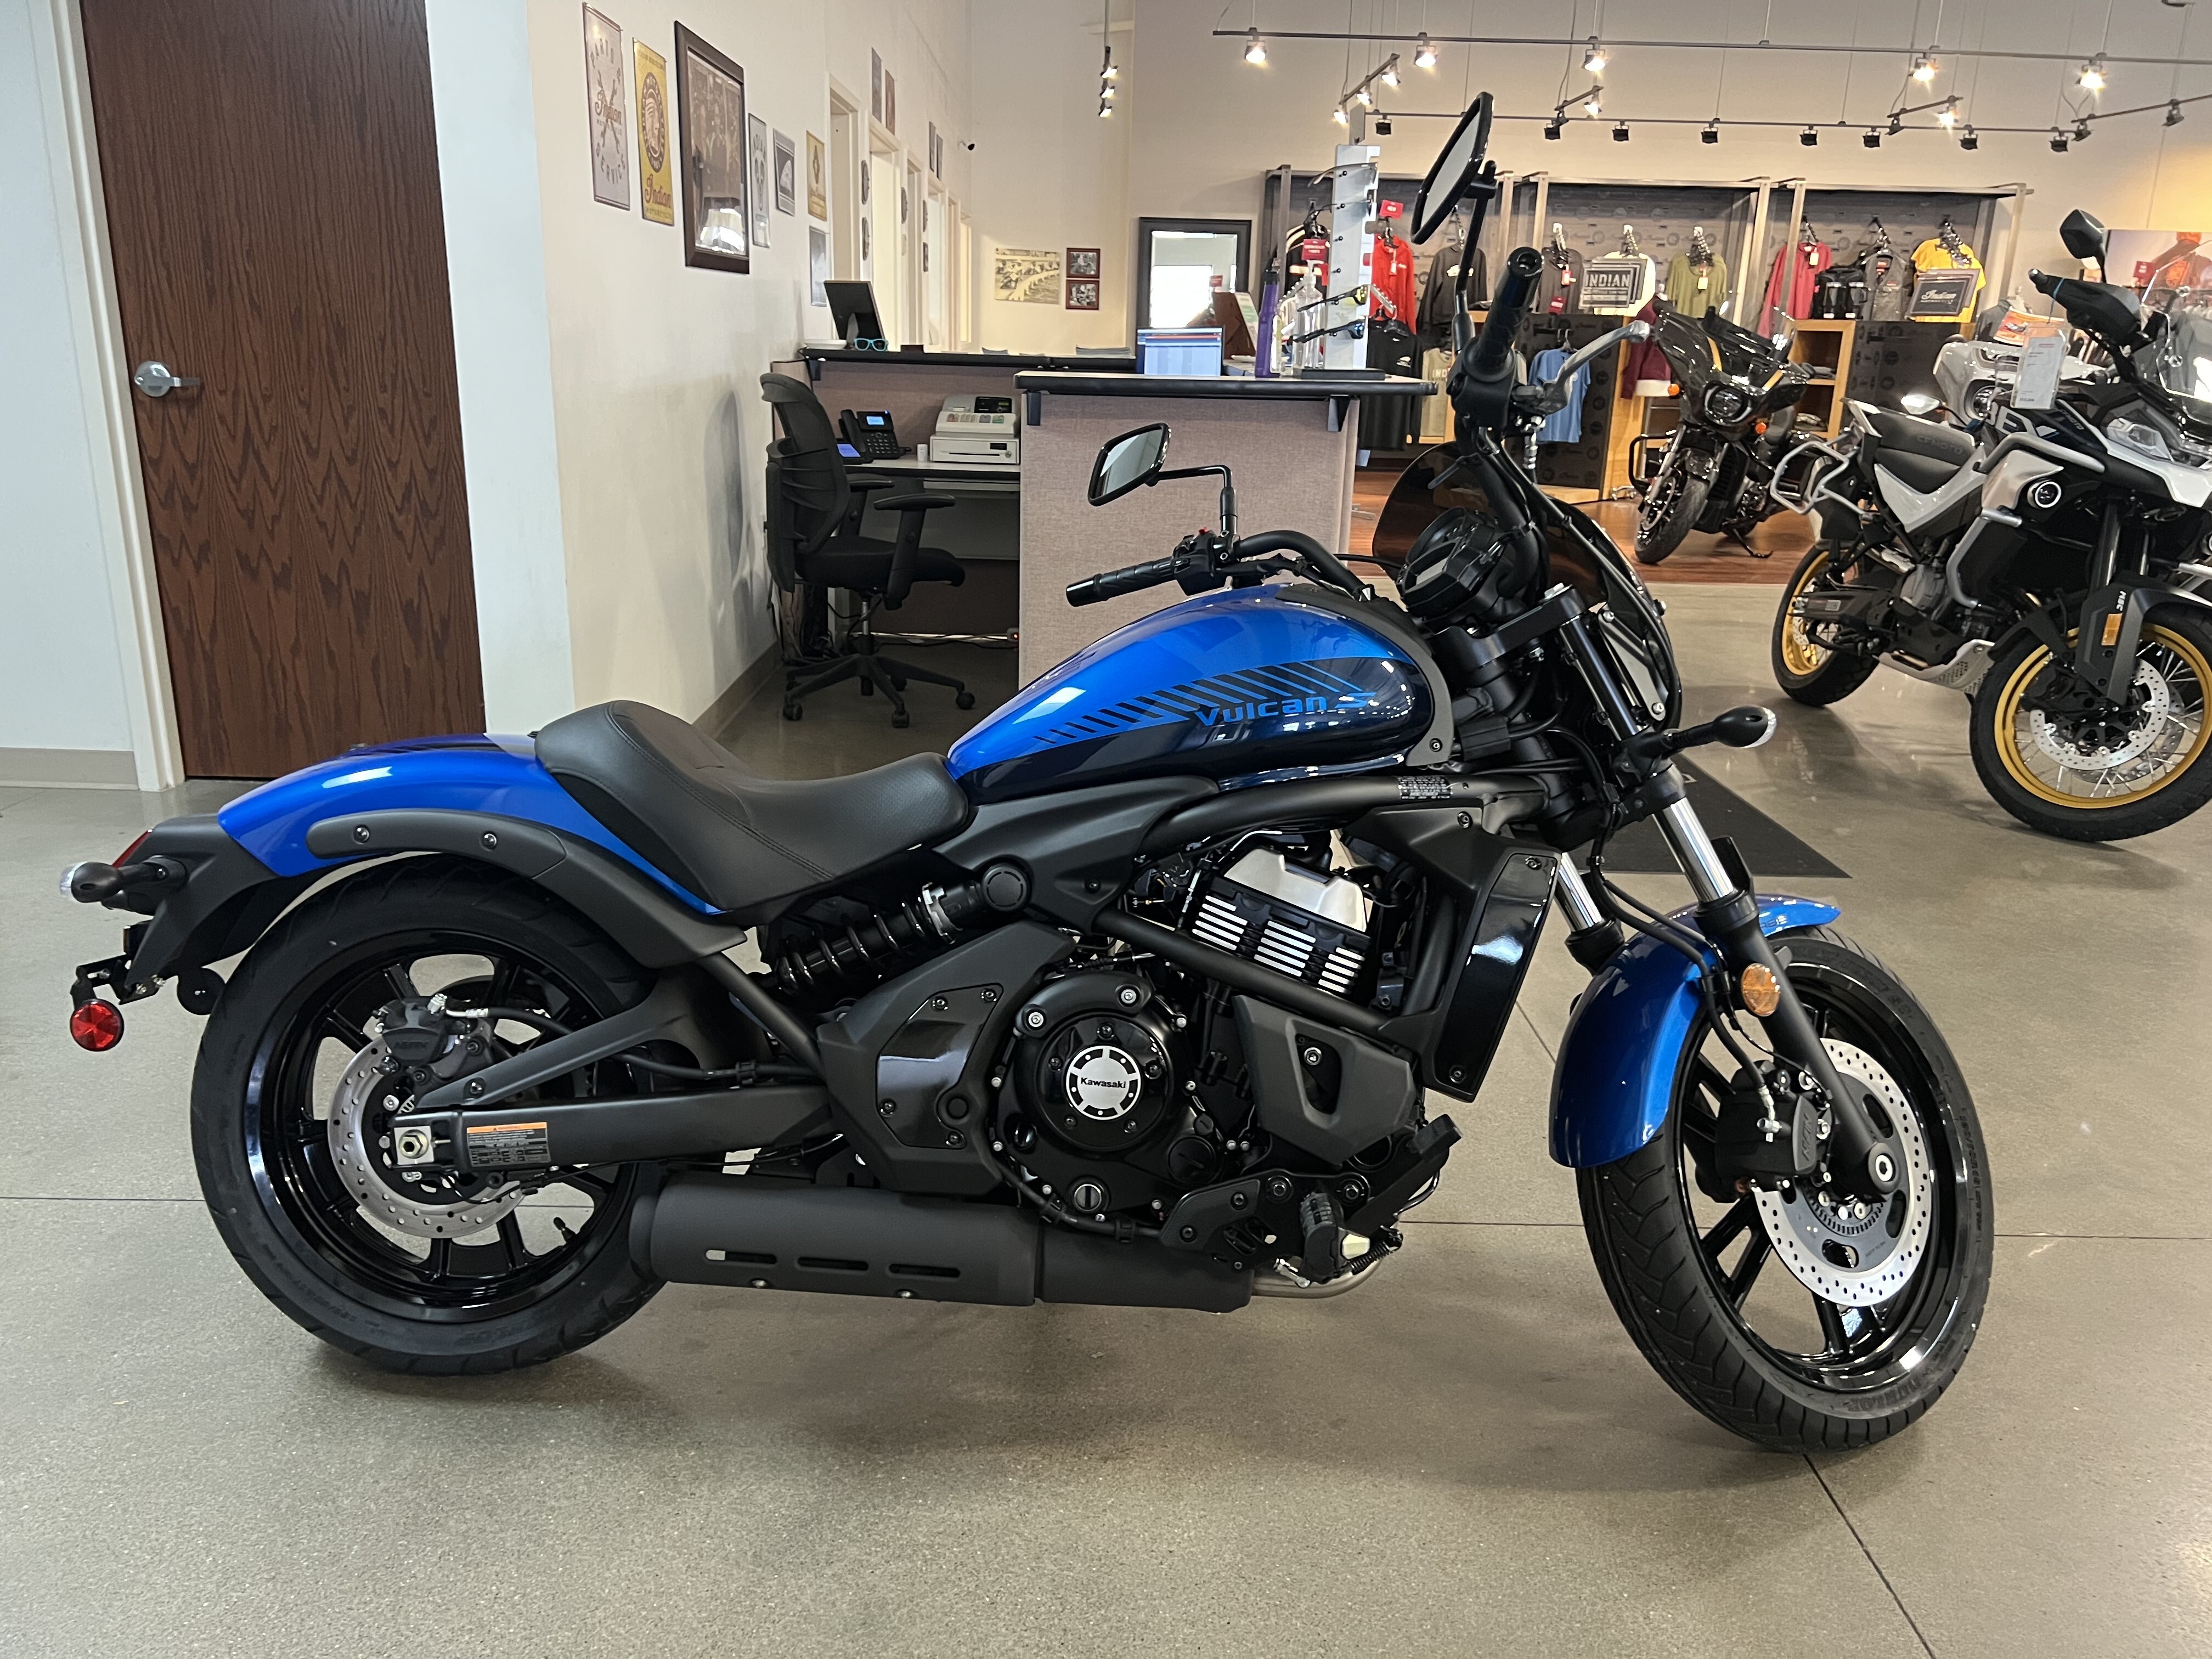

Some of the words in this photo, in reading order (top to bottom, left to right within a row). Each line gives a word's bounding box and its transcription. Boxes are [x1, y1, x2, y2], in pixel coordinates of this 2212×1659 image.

[644, 173, 671, 208] Indian
[1584, 274, 1630, 287] INDIAN
[1921, 290, 1957, 300] Indian
[1195, 696, 1327, 726] Vulcan
[1334, 692, 1376, 709] S
[1080, 1077, 1127, 1088] Kawasaki
